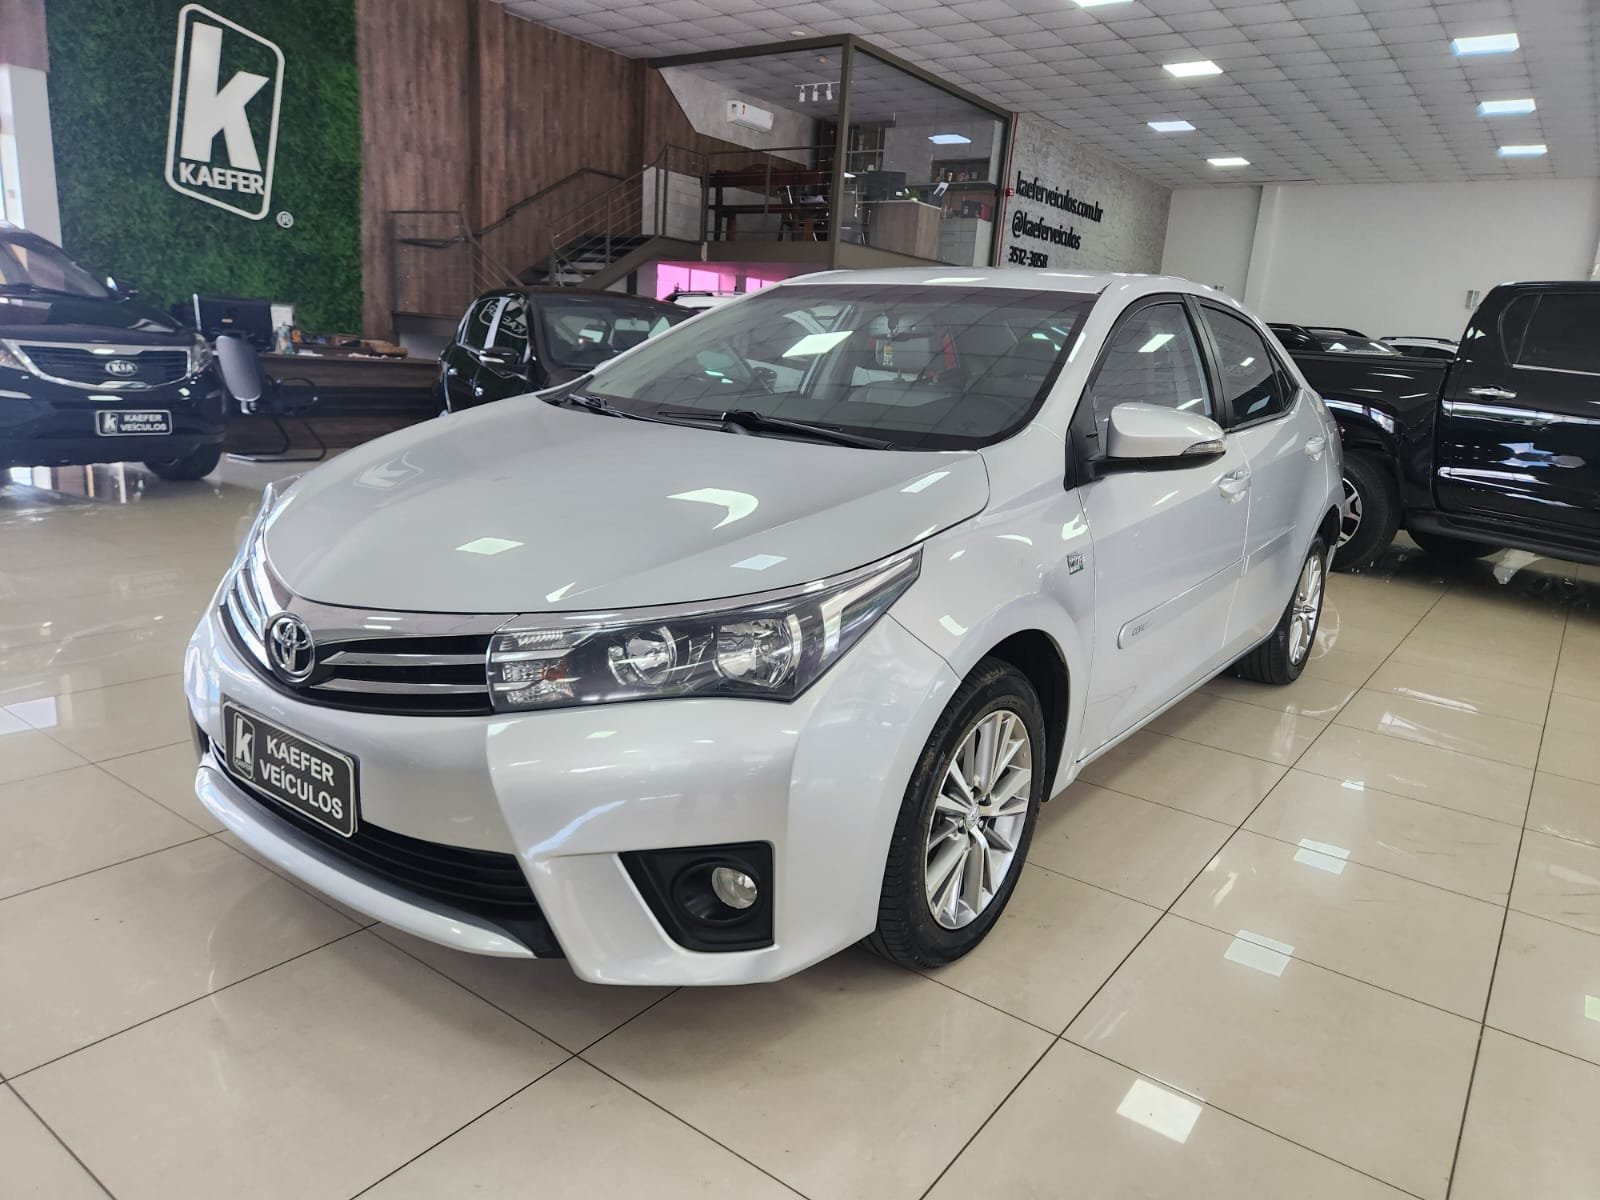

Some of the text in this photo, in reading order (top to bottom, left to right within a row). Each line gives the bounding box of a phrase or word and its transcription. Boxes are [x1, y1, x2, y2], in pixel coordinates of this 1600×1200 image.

[179, 162, 265, 195] KAEFER
[110, 362, 136, 373] KIA
[123, 413, 162, 422] KAEFER
[266, 734, 334, 786] KAEFER
[259, 758, 343, 819] VEÍCULOS
